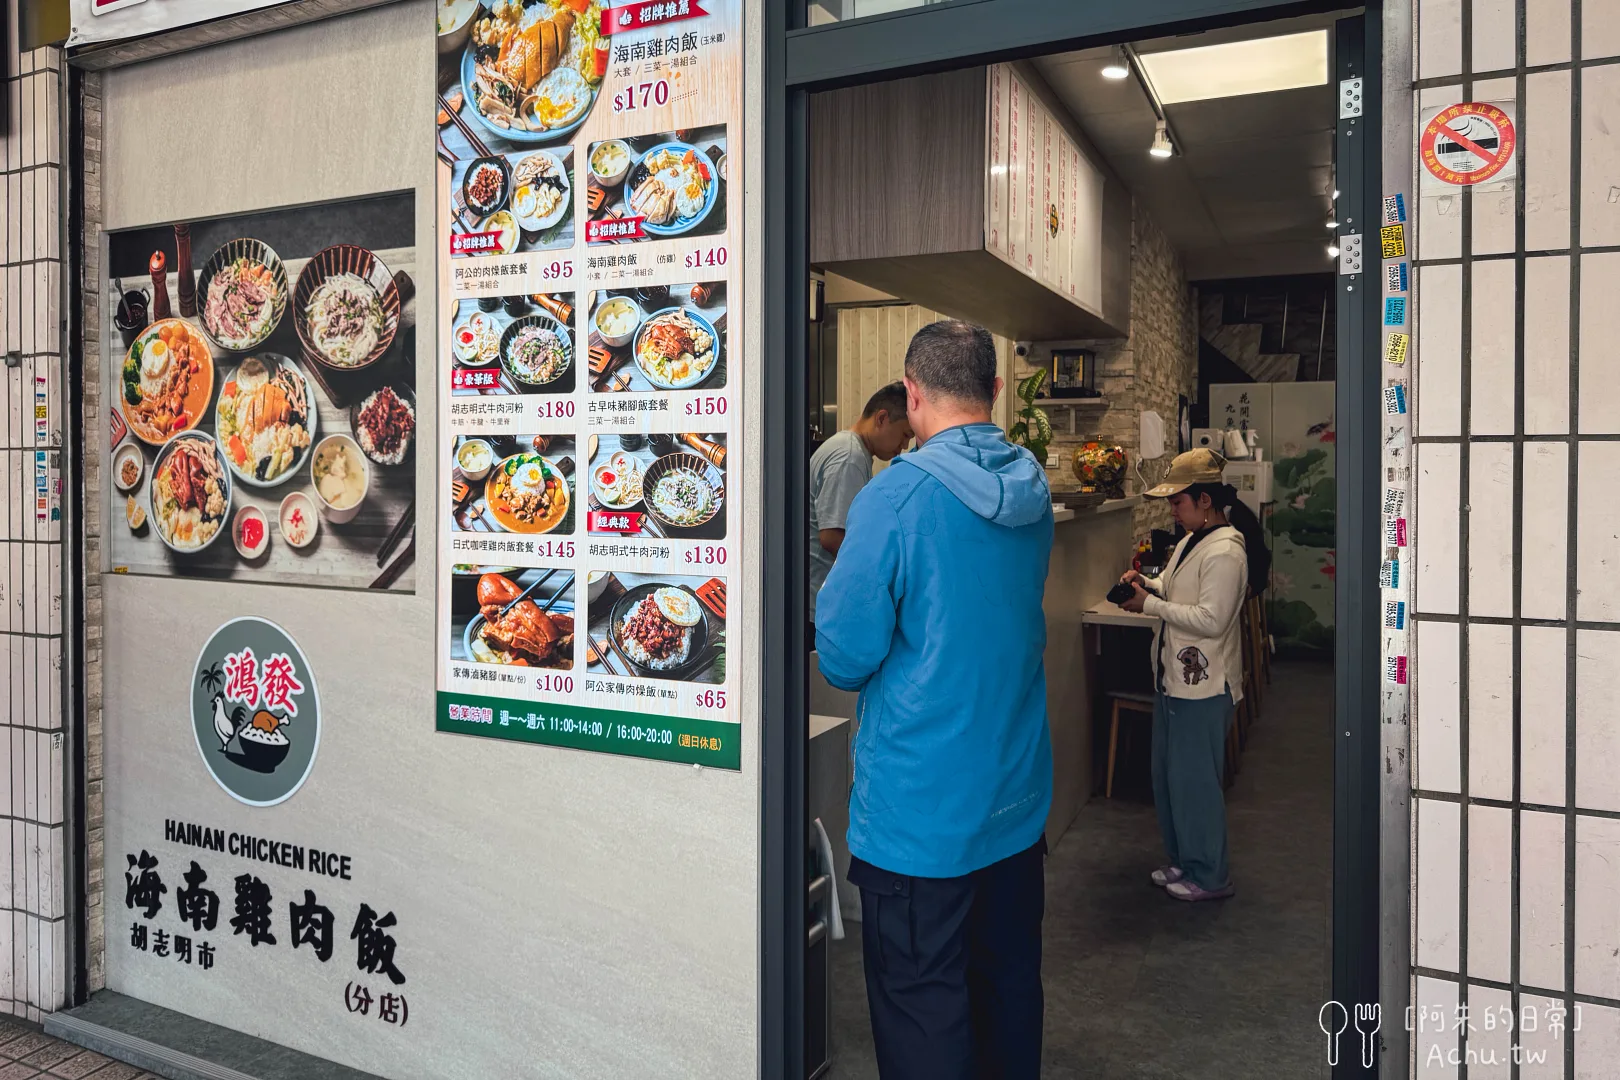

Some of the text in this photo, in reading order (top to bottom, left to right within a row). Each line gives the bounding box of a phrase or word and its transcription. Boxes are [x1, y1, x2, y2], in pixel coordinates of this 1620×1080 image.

[639, 0, 690, 23] 招牌推薦
[613, 31, 726, 64] 海南雞肉飯 (玉米雞)
[613, 67, 632, 79] 大套
[644, 55, 698, 73] 三菜一湯組合
[613, 80, 670, 112] $170
[599, 221, 636, 237] 招牌推薦
[587, 253, 637, 269] 海南雞肉飯
[685, 247, 728, 269] $140
[455, 263, 528, 280] 阿公的肉燥飯套餐
[542, 260, 573, 280] $95
[451, 402, 523, 415] 胡志明式牛肉河粉
[537, 400, 575, 418] $180
[587, 398, 669, 413] 古早味豬腳飯套餐
[685, 396, 728, 416] $150
[597, 515, 630, 529] 經典款
[453, 539, 534, 554] 日式咖哩雞肉飯套餐
[537, 540, 575, 558] $145
[589, 544, 670, 559] 胡志明式牛肉河粉
[684, 545, 728, 565] $130
[222, 649, 304, 714] 鴻發
[536, 674, 574, 694] $100
[695, 689, 727, 709] $65
[449, 703, 493, 724] 營業時間
[677, 733, 722, 751] (週日休息)
[164, 818, 352, 881] HAINAN CHICKEN RICE
[125, 849, 407, 985] 海南雞肉飯
[129, 922, 217, 970] 胡志明市
[344, 980, 409, 1027] (分店)
